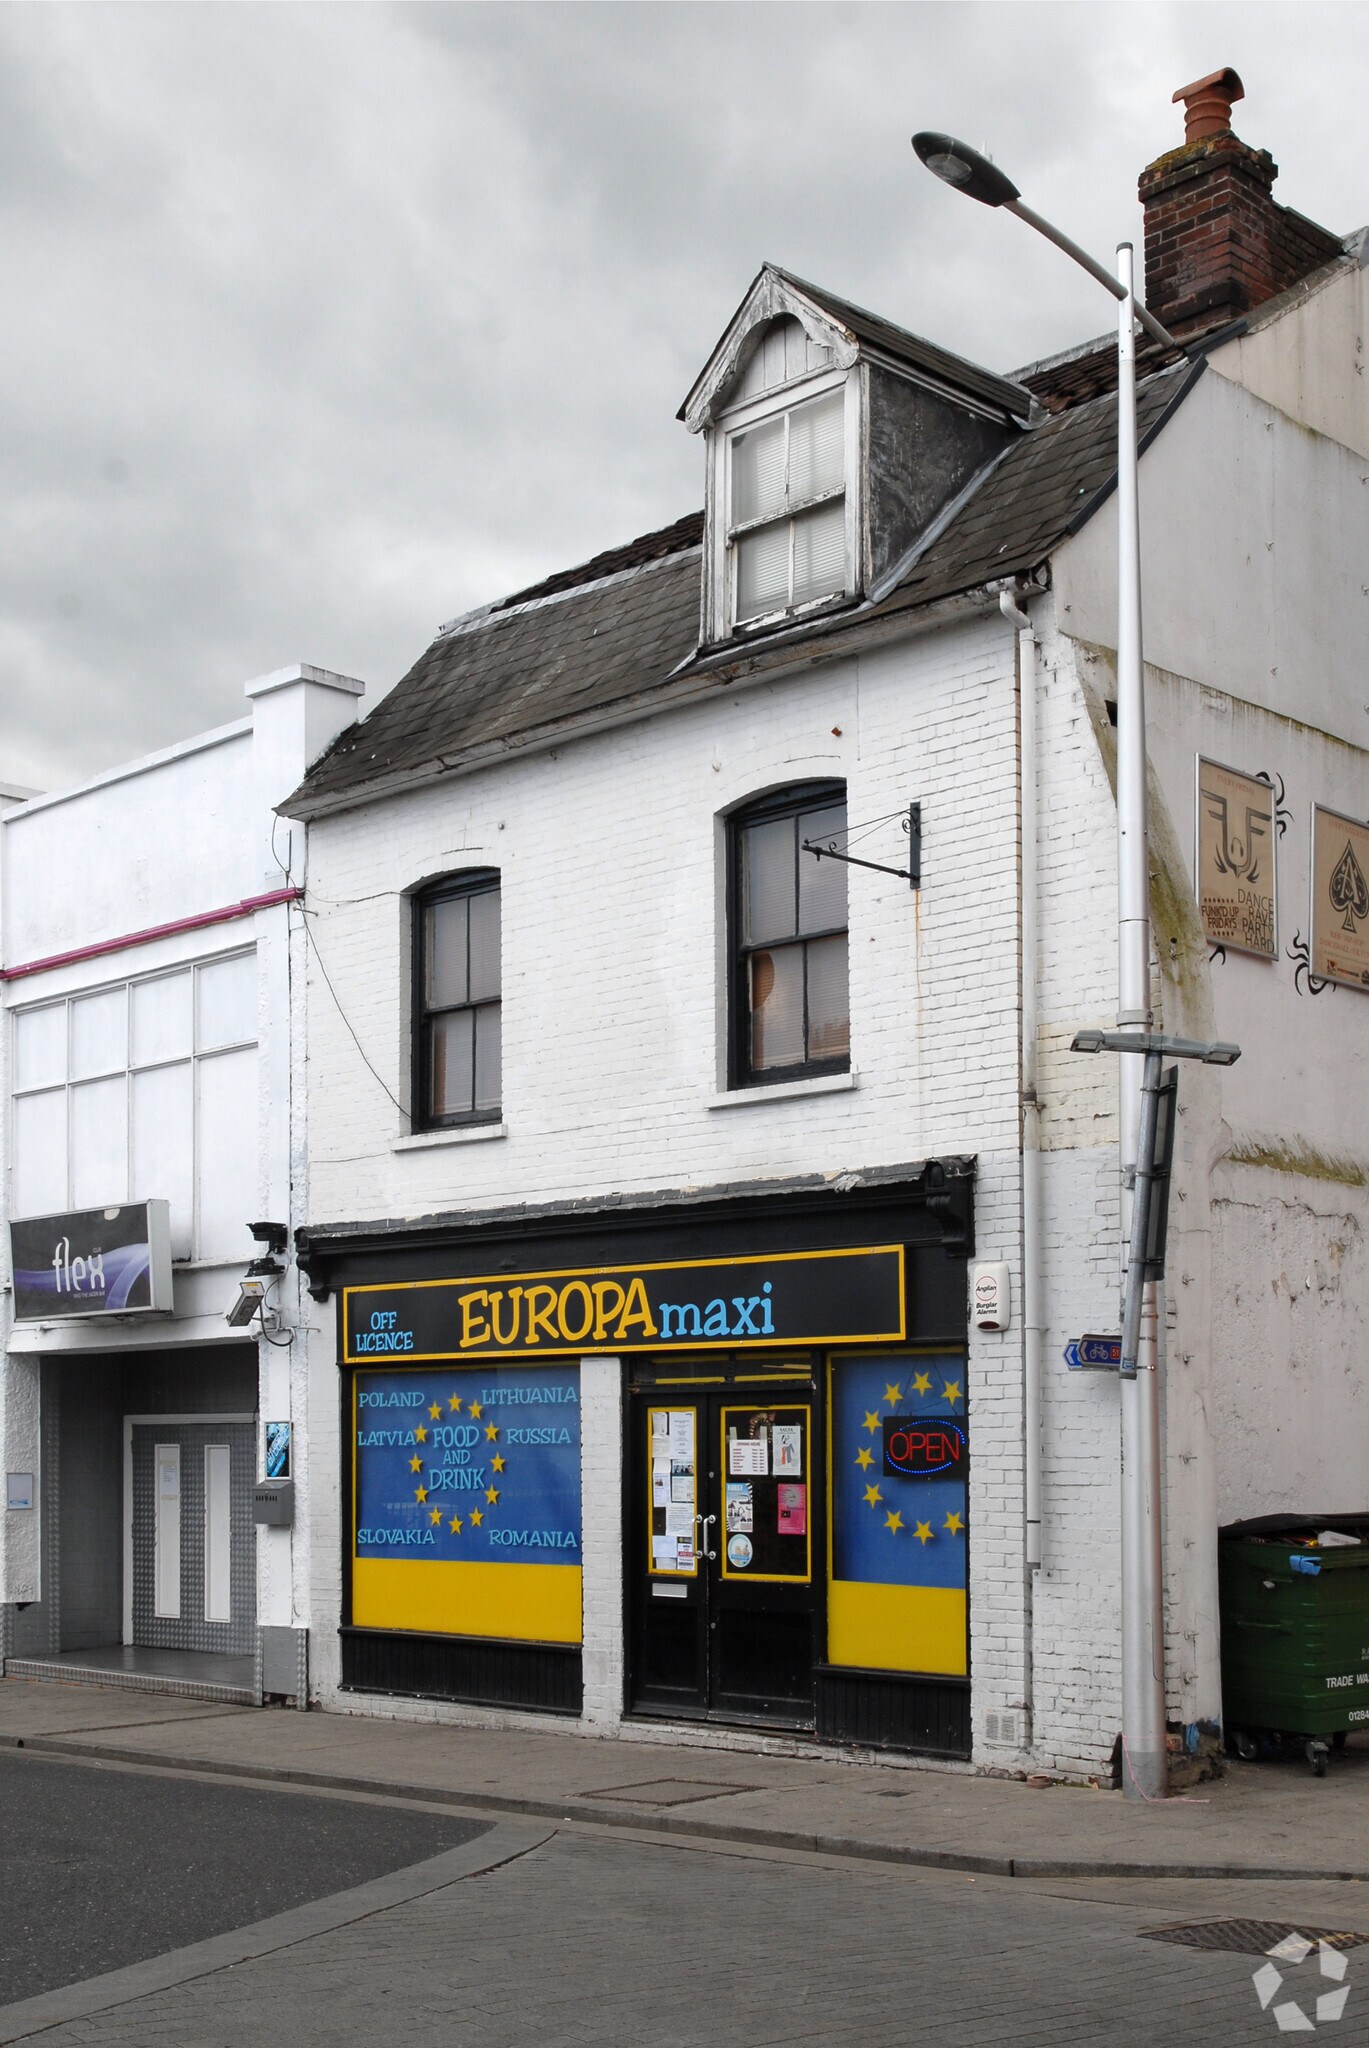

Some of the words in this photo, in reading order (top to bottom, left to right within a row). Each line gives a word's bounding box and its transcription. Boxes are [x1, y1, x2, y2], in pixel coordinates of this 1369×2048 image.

[1237, 888, 1274, 912] DANCE
[1229, 906, 1239, 917] UP
[1248, 905, 1274, 924] RAVE
[1207, 917, 1238, 929] FRIDAYS
[1242, 917, 1275, 938] PARTY
[1245, 931, 1275, 953] HARD
[52, 1236, 105, 1293] flex
[975, 1285, 997, 1293] Anglian
[370, 1310, 397, 1330] OFF
[457, 1277, 658, 1348] EUROPA
[659, 1281, 775, 1339] maxi
[355, 1329, 413, 1352] LICENCE
[1112, 1348, 1120, 1357] 51
[359, 1391, 425, 1408] POLAND
[481, 1386, 578, 1405] LITHUANIA
[358, 1431, 417, 1447] LATVIA
[432, 1425, 480, 1448] FOOD
[506, 1427, 572, 1445] RUSSIA
[889, 1431, 960, 1463] OPEN
[442, 1449, 471, 1465] AND
[428, 1467, 486, 1491] DRINK
[357, 1528, 436, 1545] SLOVAKIA
[488, 1529, 578, 1548] ROMANIA
[1325, 1674, 1354, 1689] TRADE
[1356, 1672, 1369, 1685] WA
